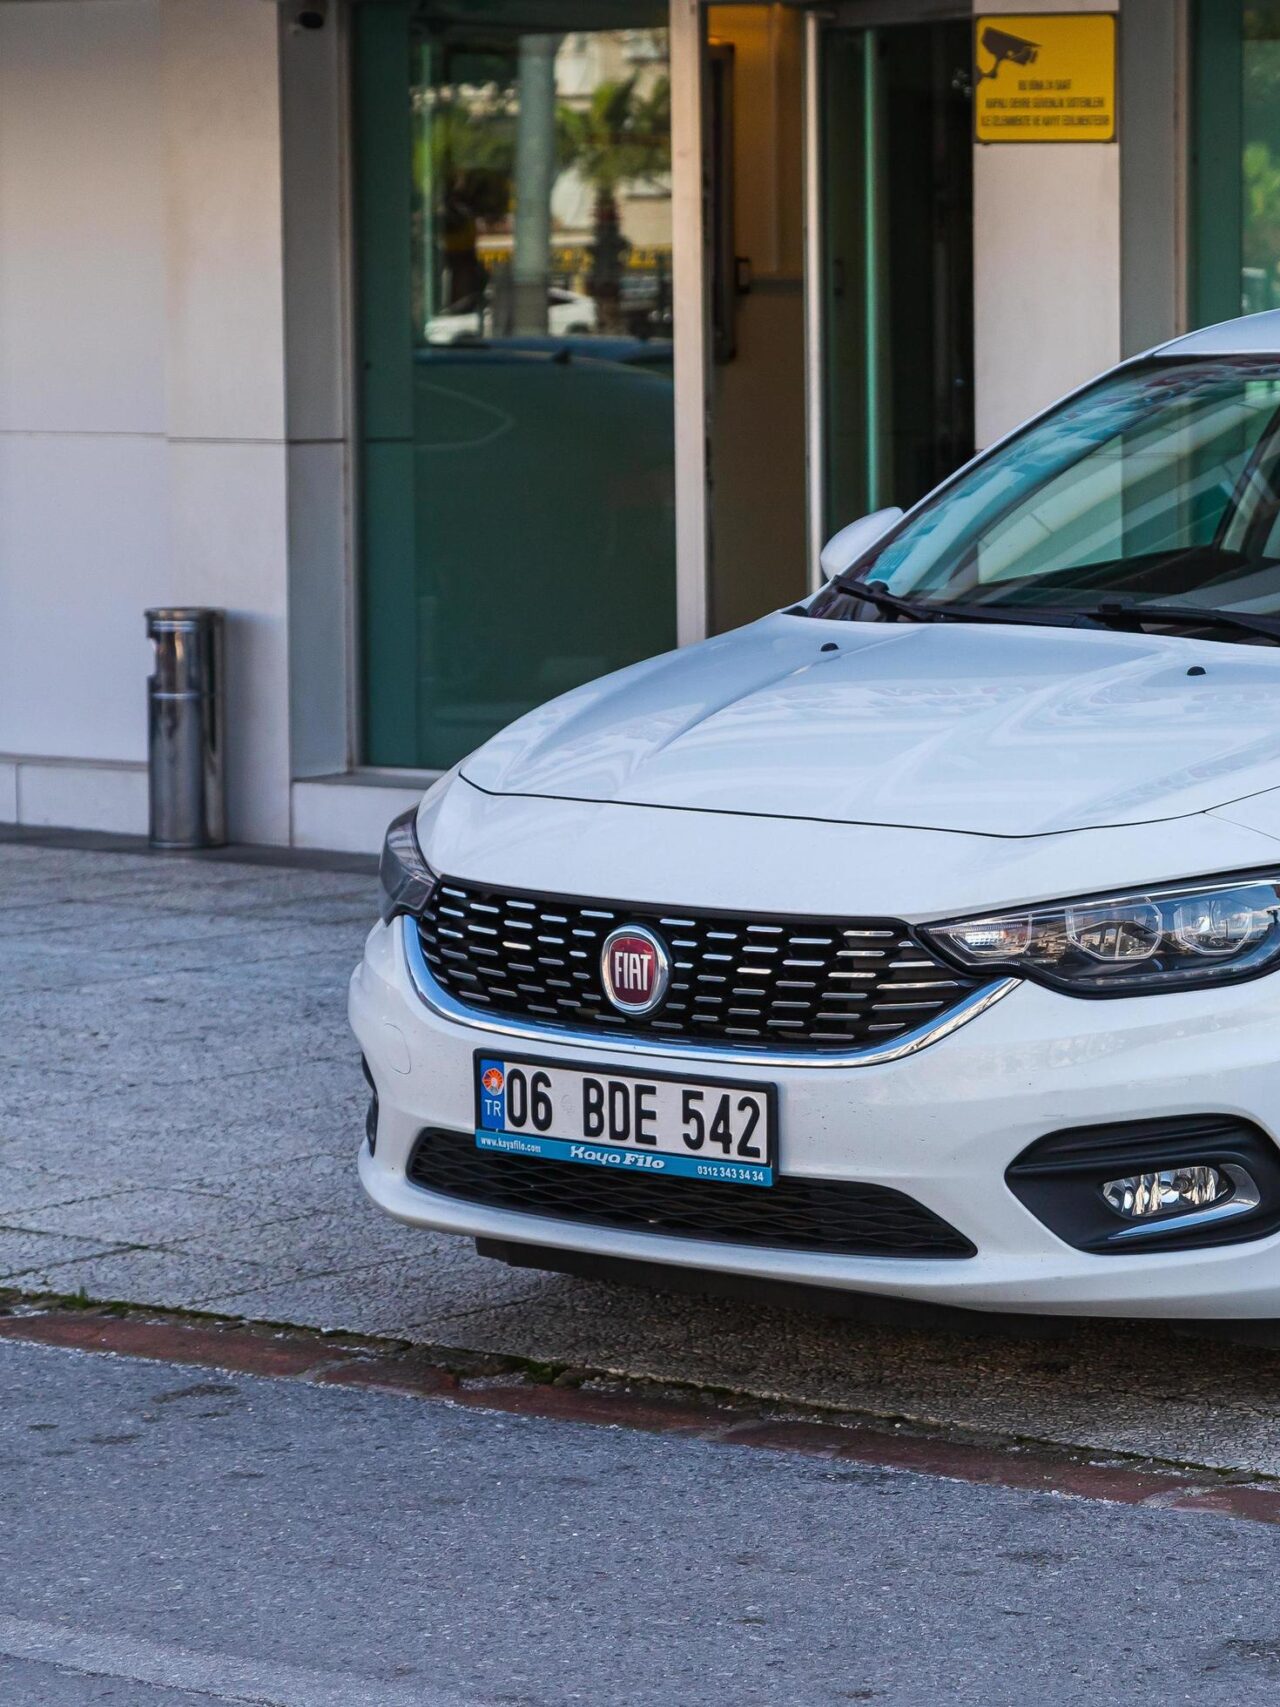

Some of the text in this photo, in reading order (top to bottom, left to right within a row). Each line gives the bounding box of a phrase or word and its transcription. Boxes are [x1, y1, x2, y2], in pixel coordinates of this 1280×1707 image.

[614, 951, 652, 991] FIAT
[484, 1099, 501, 1117] TR
[506, 1068, 761, 1158] 06 BDE 542
[480, 1137, 542, 1153] www.kayafilo.com
[569, 1145, 665, 1169] Kaya Filo
[697, 1165, 765, 1181] 0312 343 34 34
